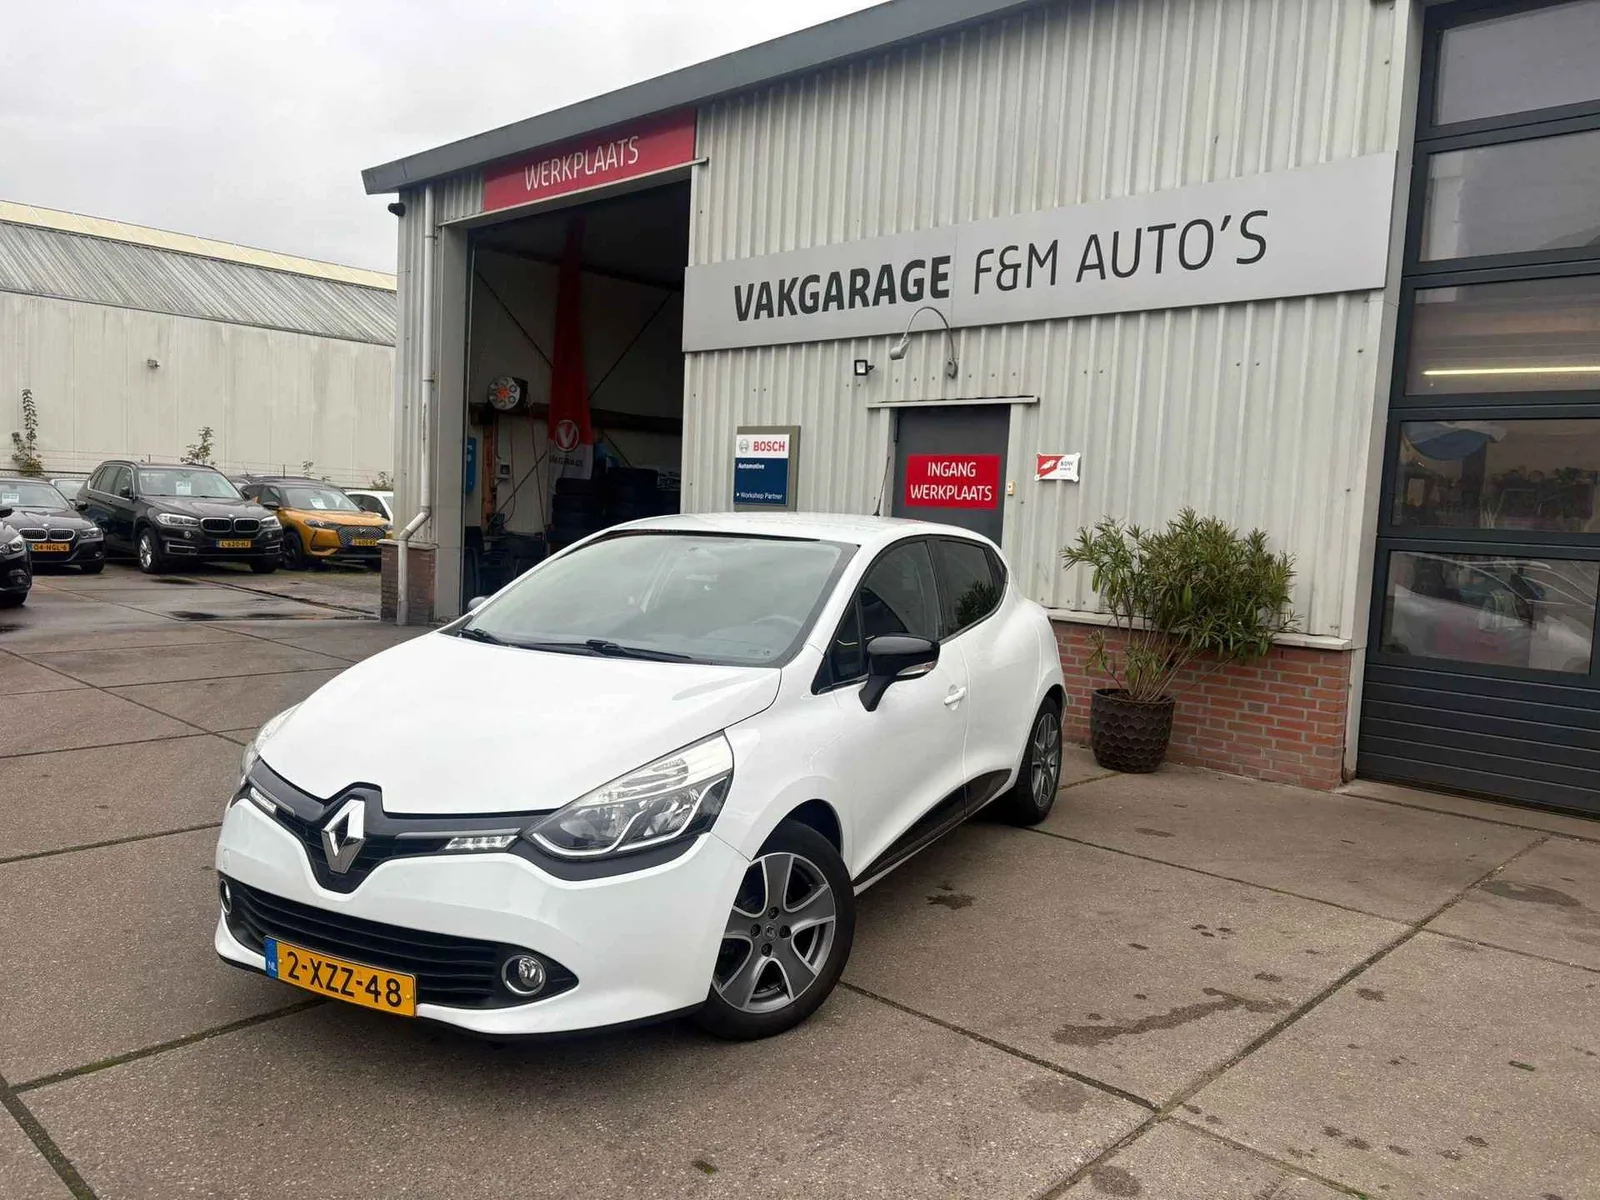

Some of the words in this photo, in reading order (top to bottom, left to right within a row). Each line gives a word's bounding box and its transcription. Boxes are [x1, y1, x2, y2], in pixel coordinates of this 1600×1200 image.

[524, 136, 639, 191] WERKPLAATS
[734, 255, 951, 321] VAKGARAGE
[973, 239, 1059, 294] F&M
[1076, 210, 1269, 282] AUTO'S
[753, 441, 785, 452] BOSCH
[927, 462, 977, 477] INGANG
[910, 484, 992, 501] WERKPLAATS
[268, 961, 277, 971] NL
[287, 951, 402, 1007] 2-XZZ-48
